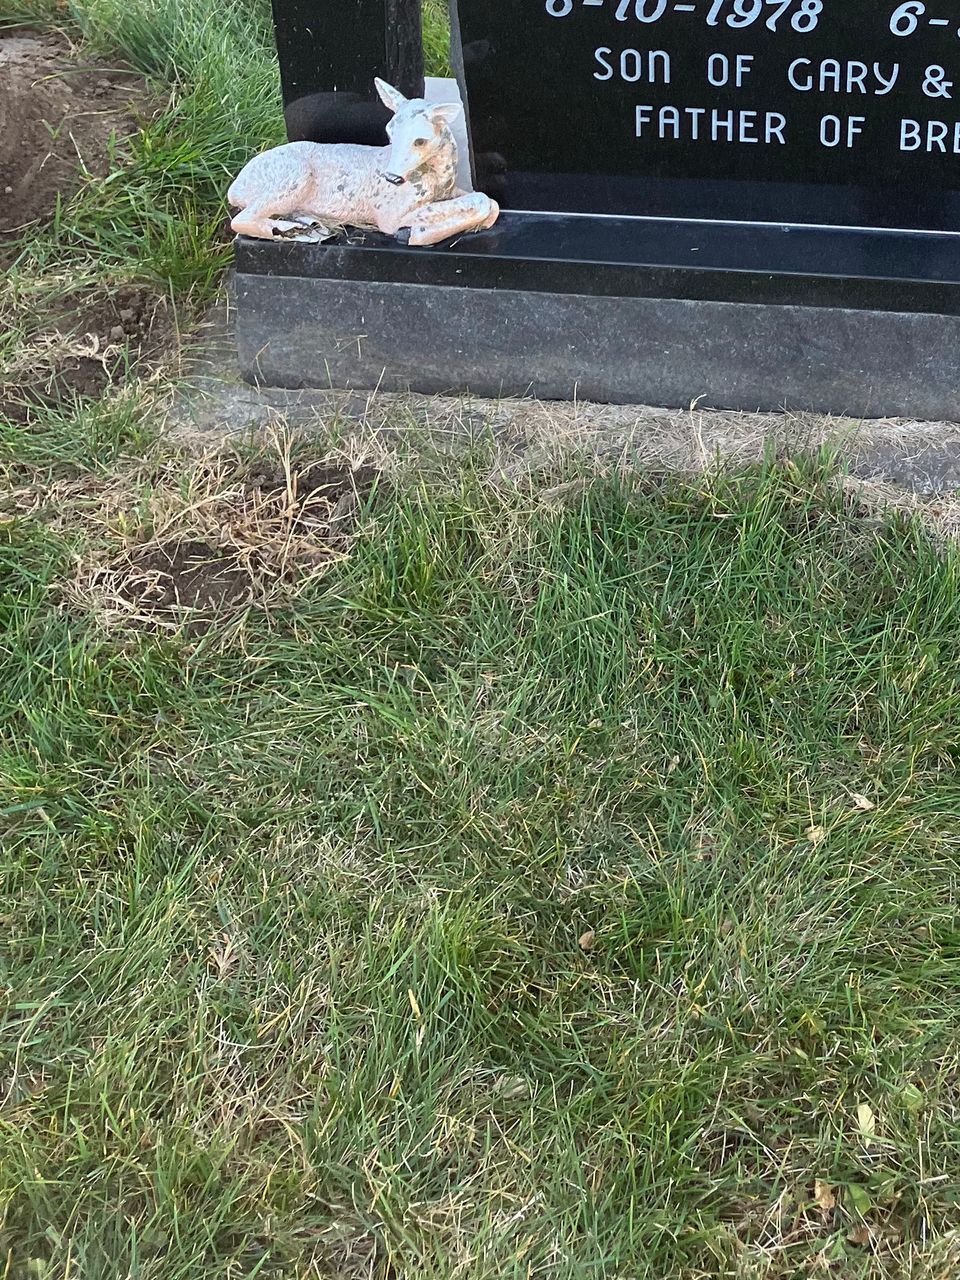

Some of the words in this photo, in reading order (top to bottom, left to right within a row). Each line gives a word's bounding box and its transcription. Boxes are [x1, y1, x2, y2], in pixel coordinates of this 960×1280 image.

[594, 47, 670, 84] SON
[707, 54, 754, 87] OF
[788, 57, 900, 95] GARY
[922, 64, 953, 99] &
[635, 105, 787, 145] FATHER
[820, 114, 865, 148] OF
